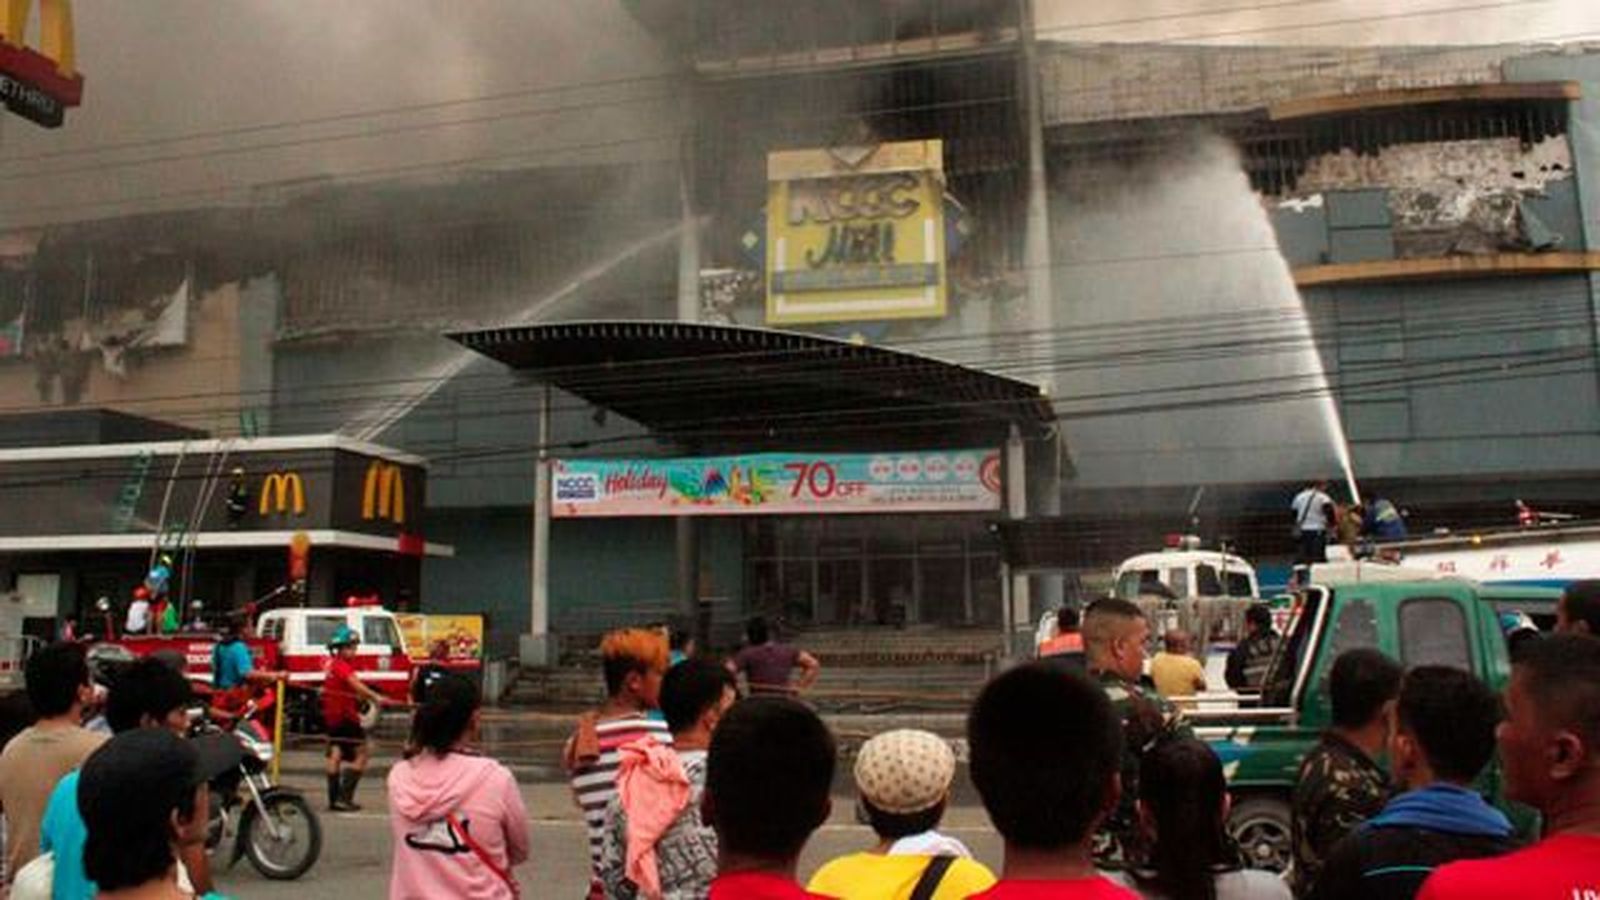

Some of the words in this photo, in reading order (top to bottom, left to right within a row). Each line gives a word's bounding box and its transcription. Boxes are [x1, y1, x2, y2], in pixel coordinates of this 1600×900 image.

[604, 466, 668, 499] Holiday
[784, 460, 836, 498] 70
[836, 482, 867, 496] OFF
